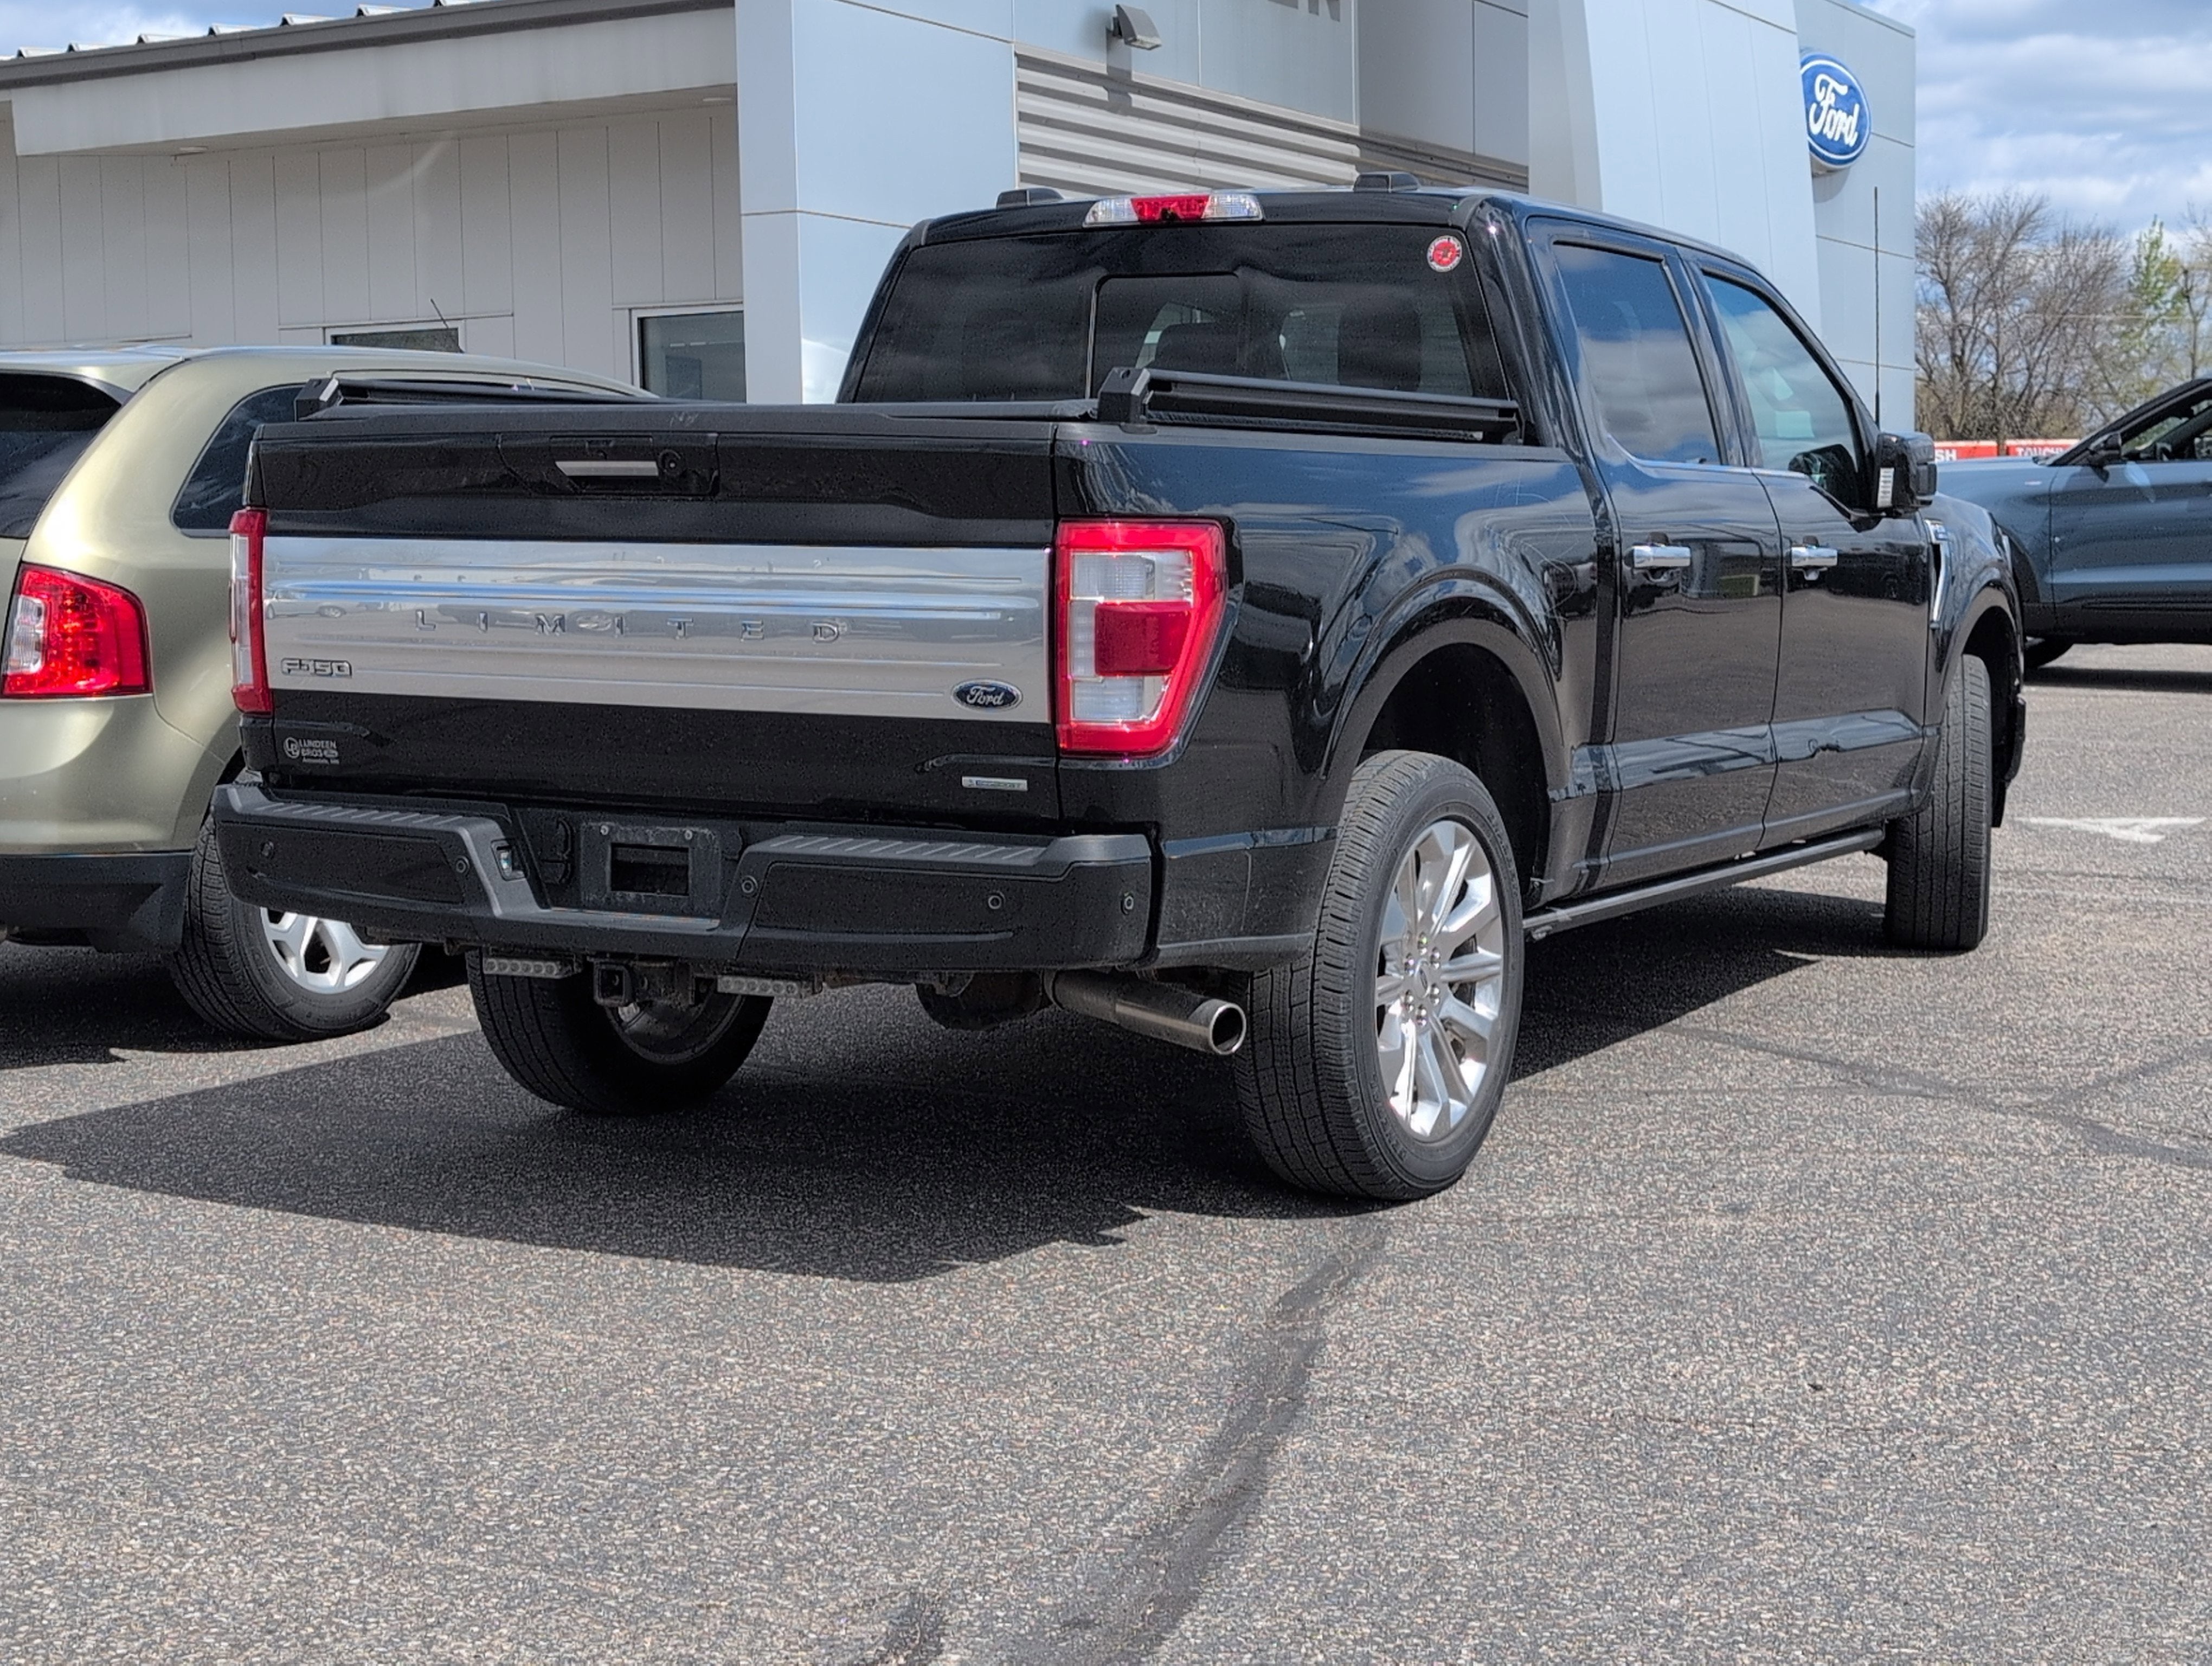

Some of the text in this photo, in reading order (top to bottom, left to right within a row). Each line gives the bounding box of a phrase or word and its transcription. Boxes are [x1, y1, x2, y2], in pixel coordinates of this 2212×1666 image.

[1809, 73, 1860, 148] Ford
[1935, 448, 1957, 462] SH
[415, 610, 840, 644] LIMITED
[281, 657, 352, 678] F-150
[966, 685, 1005, 706] Ford
